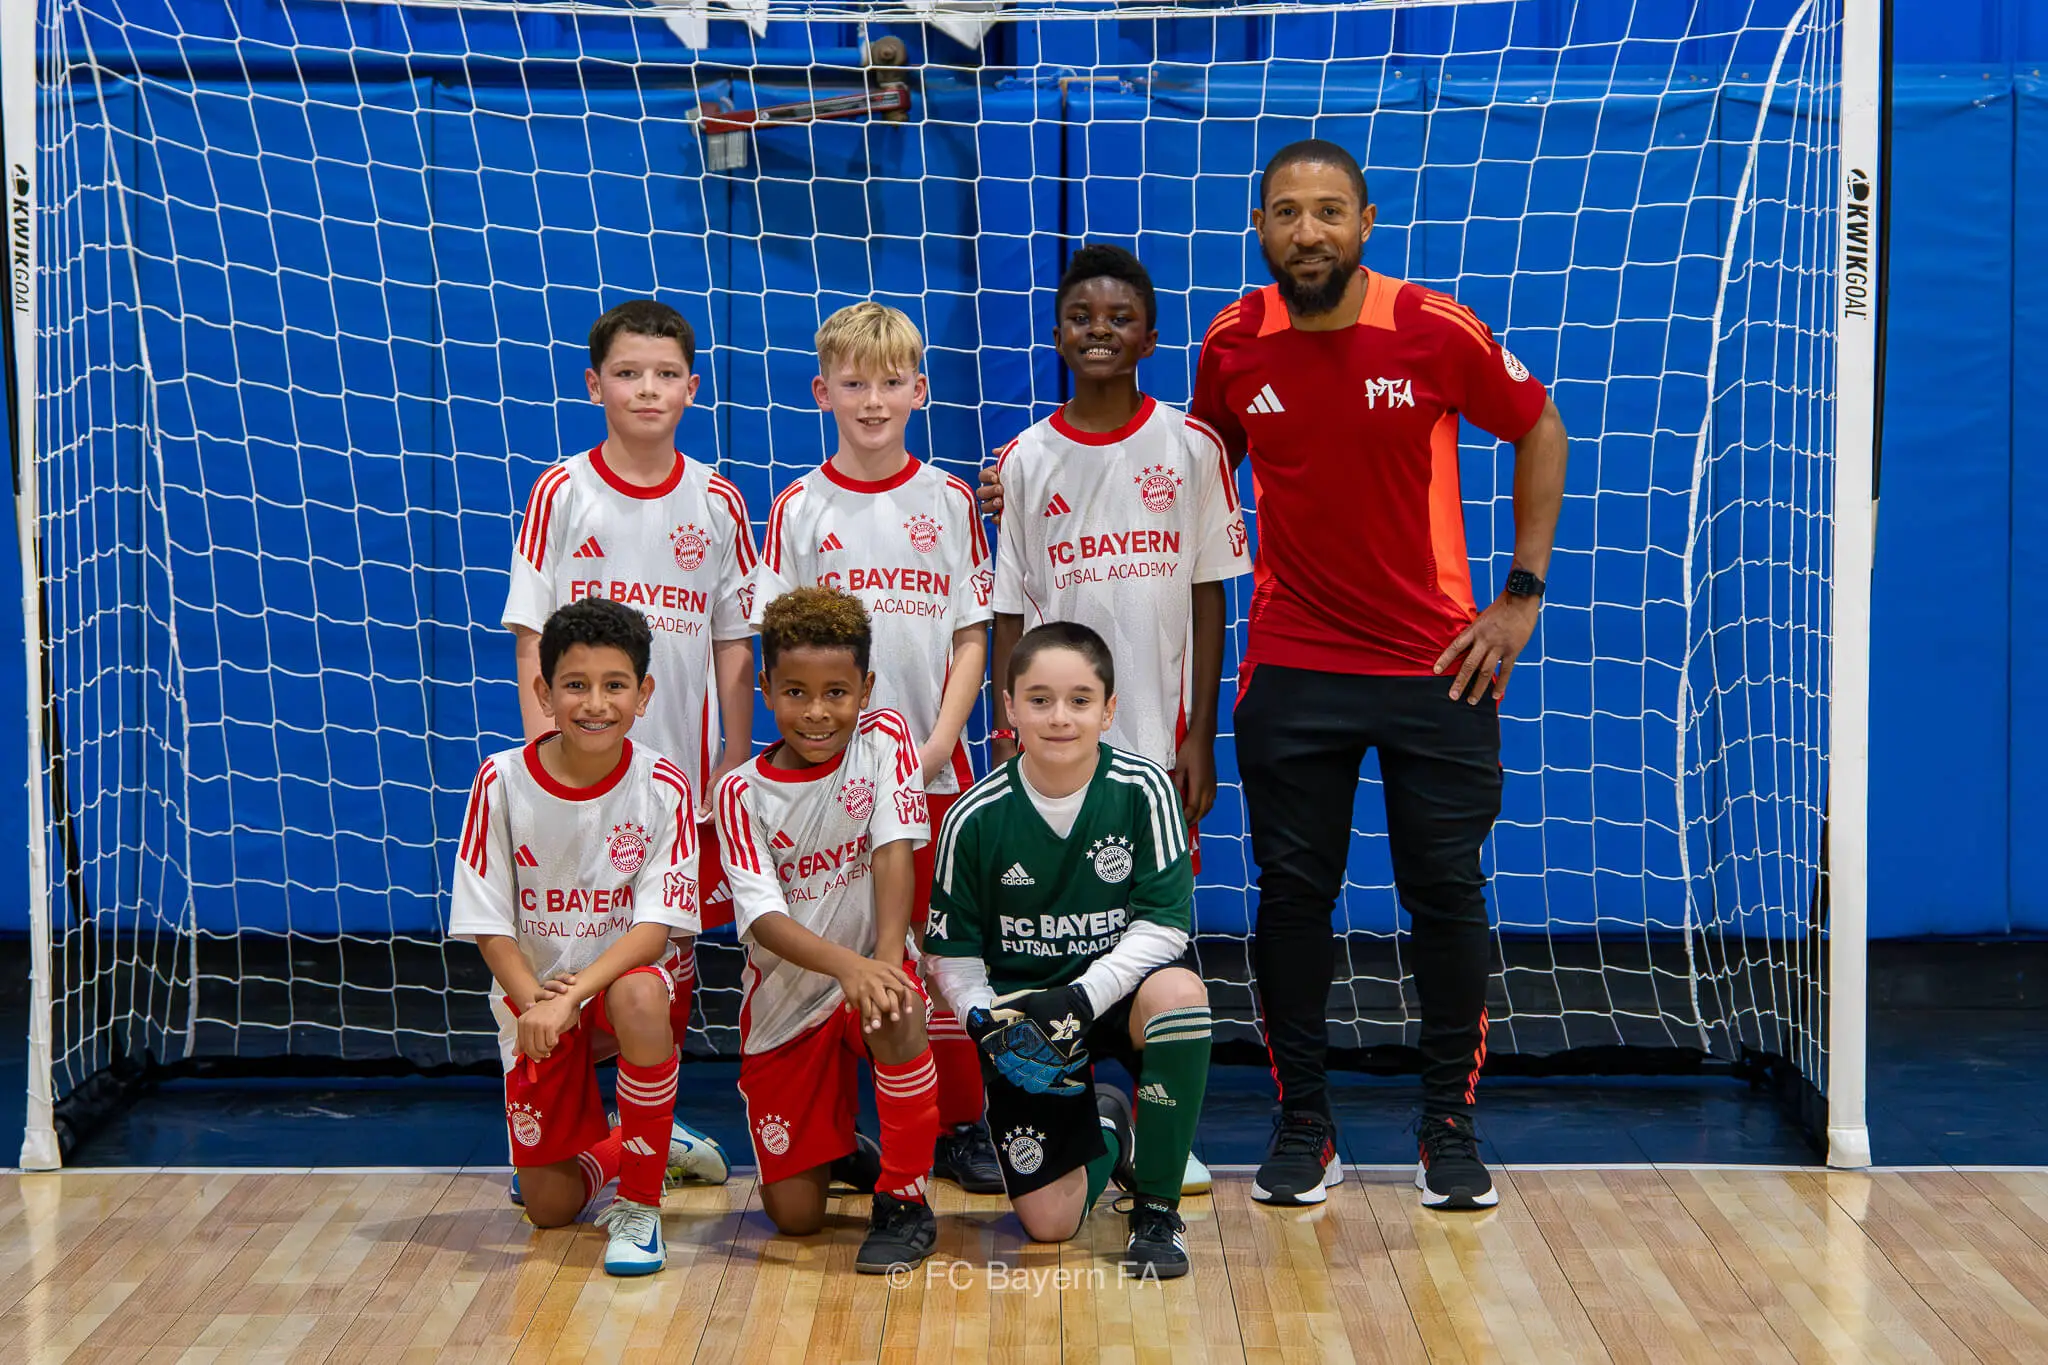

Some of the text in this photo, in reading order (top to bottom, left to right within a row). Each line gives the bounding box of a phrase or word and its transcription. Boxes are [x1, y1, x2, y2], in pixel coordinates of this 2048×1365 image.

[1079, 530, 1180, 559] BAYERN
[848, 567, 951, 597] BAYERN
[1054, 567, 1103, 590] UTSAL
[609, 581, 708, 614] BAYERN
[873, 598, 947, 619] ACADEMY
[644, 614, 703, 637] CADEMY
[798, 834, 869, 879] BAYER
[1001, 877, 1036, 886] adidas
[520, 919, 570, 937] UTSAL
[1000, 915, 1035, 937] FC
[1001, 931, 1122, 957] FUTSAL ACADE
